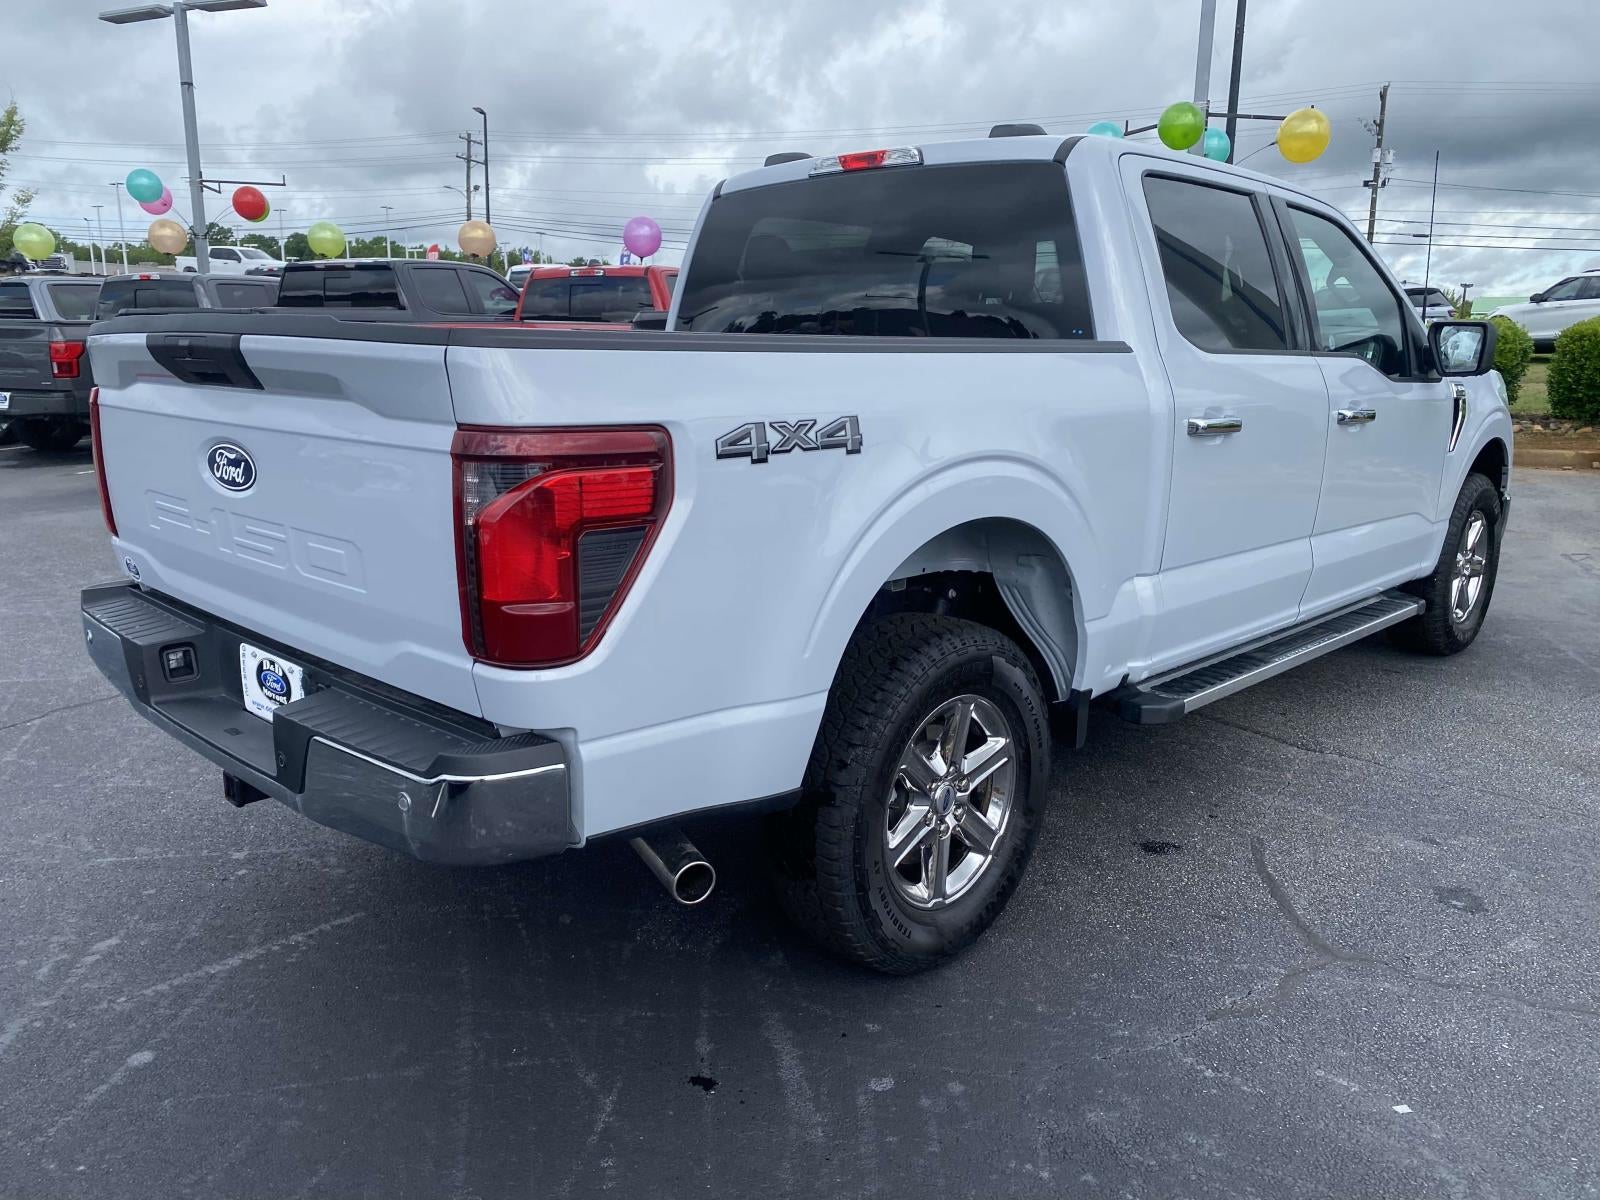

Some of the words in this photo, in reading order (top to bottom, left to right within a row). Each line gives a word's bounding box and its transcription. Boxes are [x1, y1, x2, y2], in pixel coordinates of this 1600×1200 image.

[214, 449, 244, 483] Ford
[144, 489, 367, 594] F-150
[262, 660, 283, 677] D&D
[266, 673, 281, 692] Ford
[877, 885, 912, 939] TERRITORY
